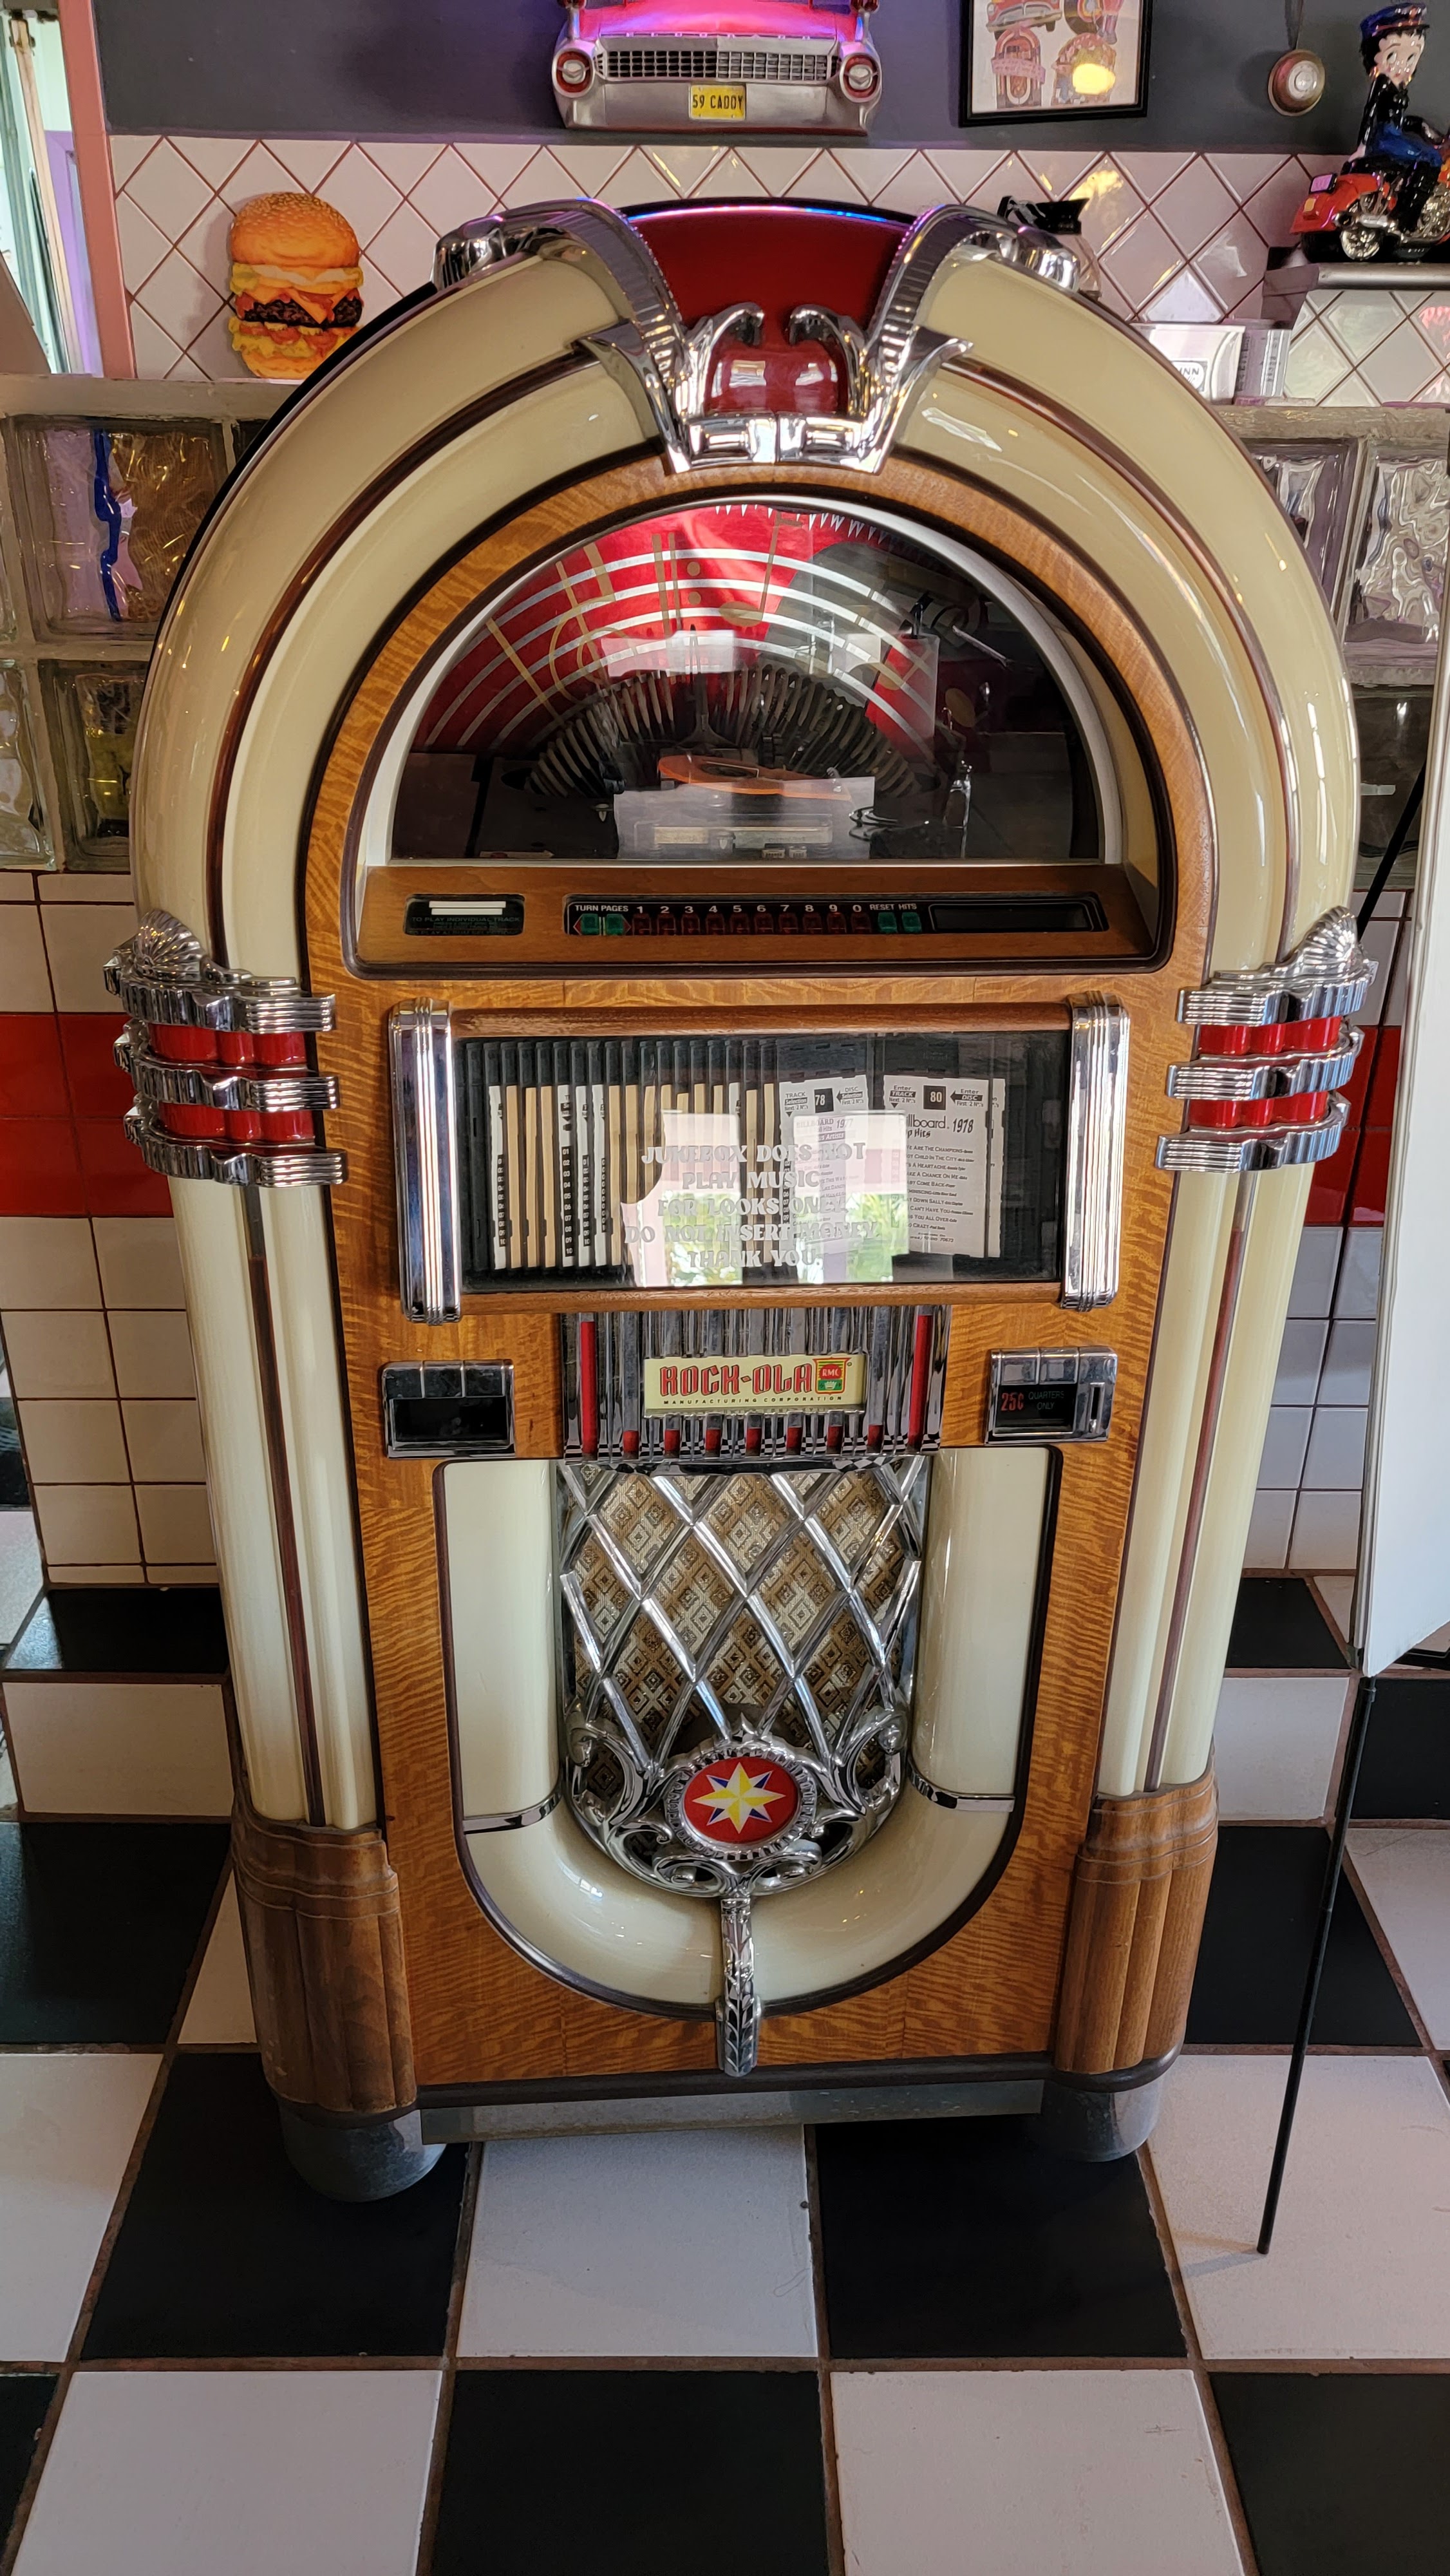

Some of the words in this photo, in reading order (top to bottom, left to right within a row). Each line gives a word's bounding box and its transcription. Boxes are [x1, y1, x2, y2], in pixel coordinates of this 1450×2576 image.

[693, 94, 705, 109] 59
[710, 95, 743, 110] CADDY
[660, 905, 670, 914] 2
[684, 905, 694, 914] 3
[757, 904, 767, 913] 6
[805, 904, 814, 913] 8
[829, 904, 838, 913] 9
[852, 904, 862, 913] 0
[814, 1094, 825, 1106] 78
[930, 1092, 942, 1103] 80
[914, 1128, 931, 1138] Hits
[953, 1118, 974, 1133] 1978
[641, 1144, 748, 1164] JUKEBOX
[757, 1144, 812, 1162] DOES
[821, 1142, 865, 1160] NOT
[683, 1171, 740, 1189] PLAY
[747, 1170, 820, 1189] MUSIC
[658, 1198, 697, 1217] FOR
[708, 1197, 780, 1217] LOOKS
[625, 1226, 655, 1244] DO
[664, 1225, 707, 1244] NOT
[716, 1224, 791, 1243] INSERT
[799, 1221, 876, 1240] MONEY
[688, 1251, 764, 1268] THANK
[769, 1249, 816, 1267] YOU
[660, 1363, 813, 1396] ROCK-OLA
[822, 1368, 840, 1377] RMC
[1028, 1390, 1064, 1400] QUARTERS
